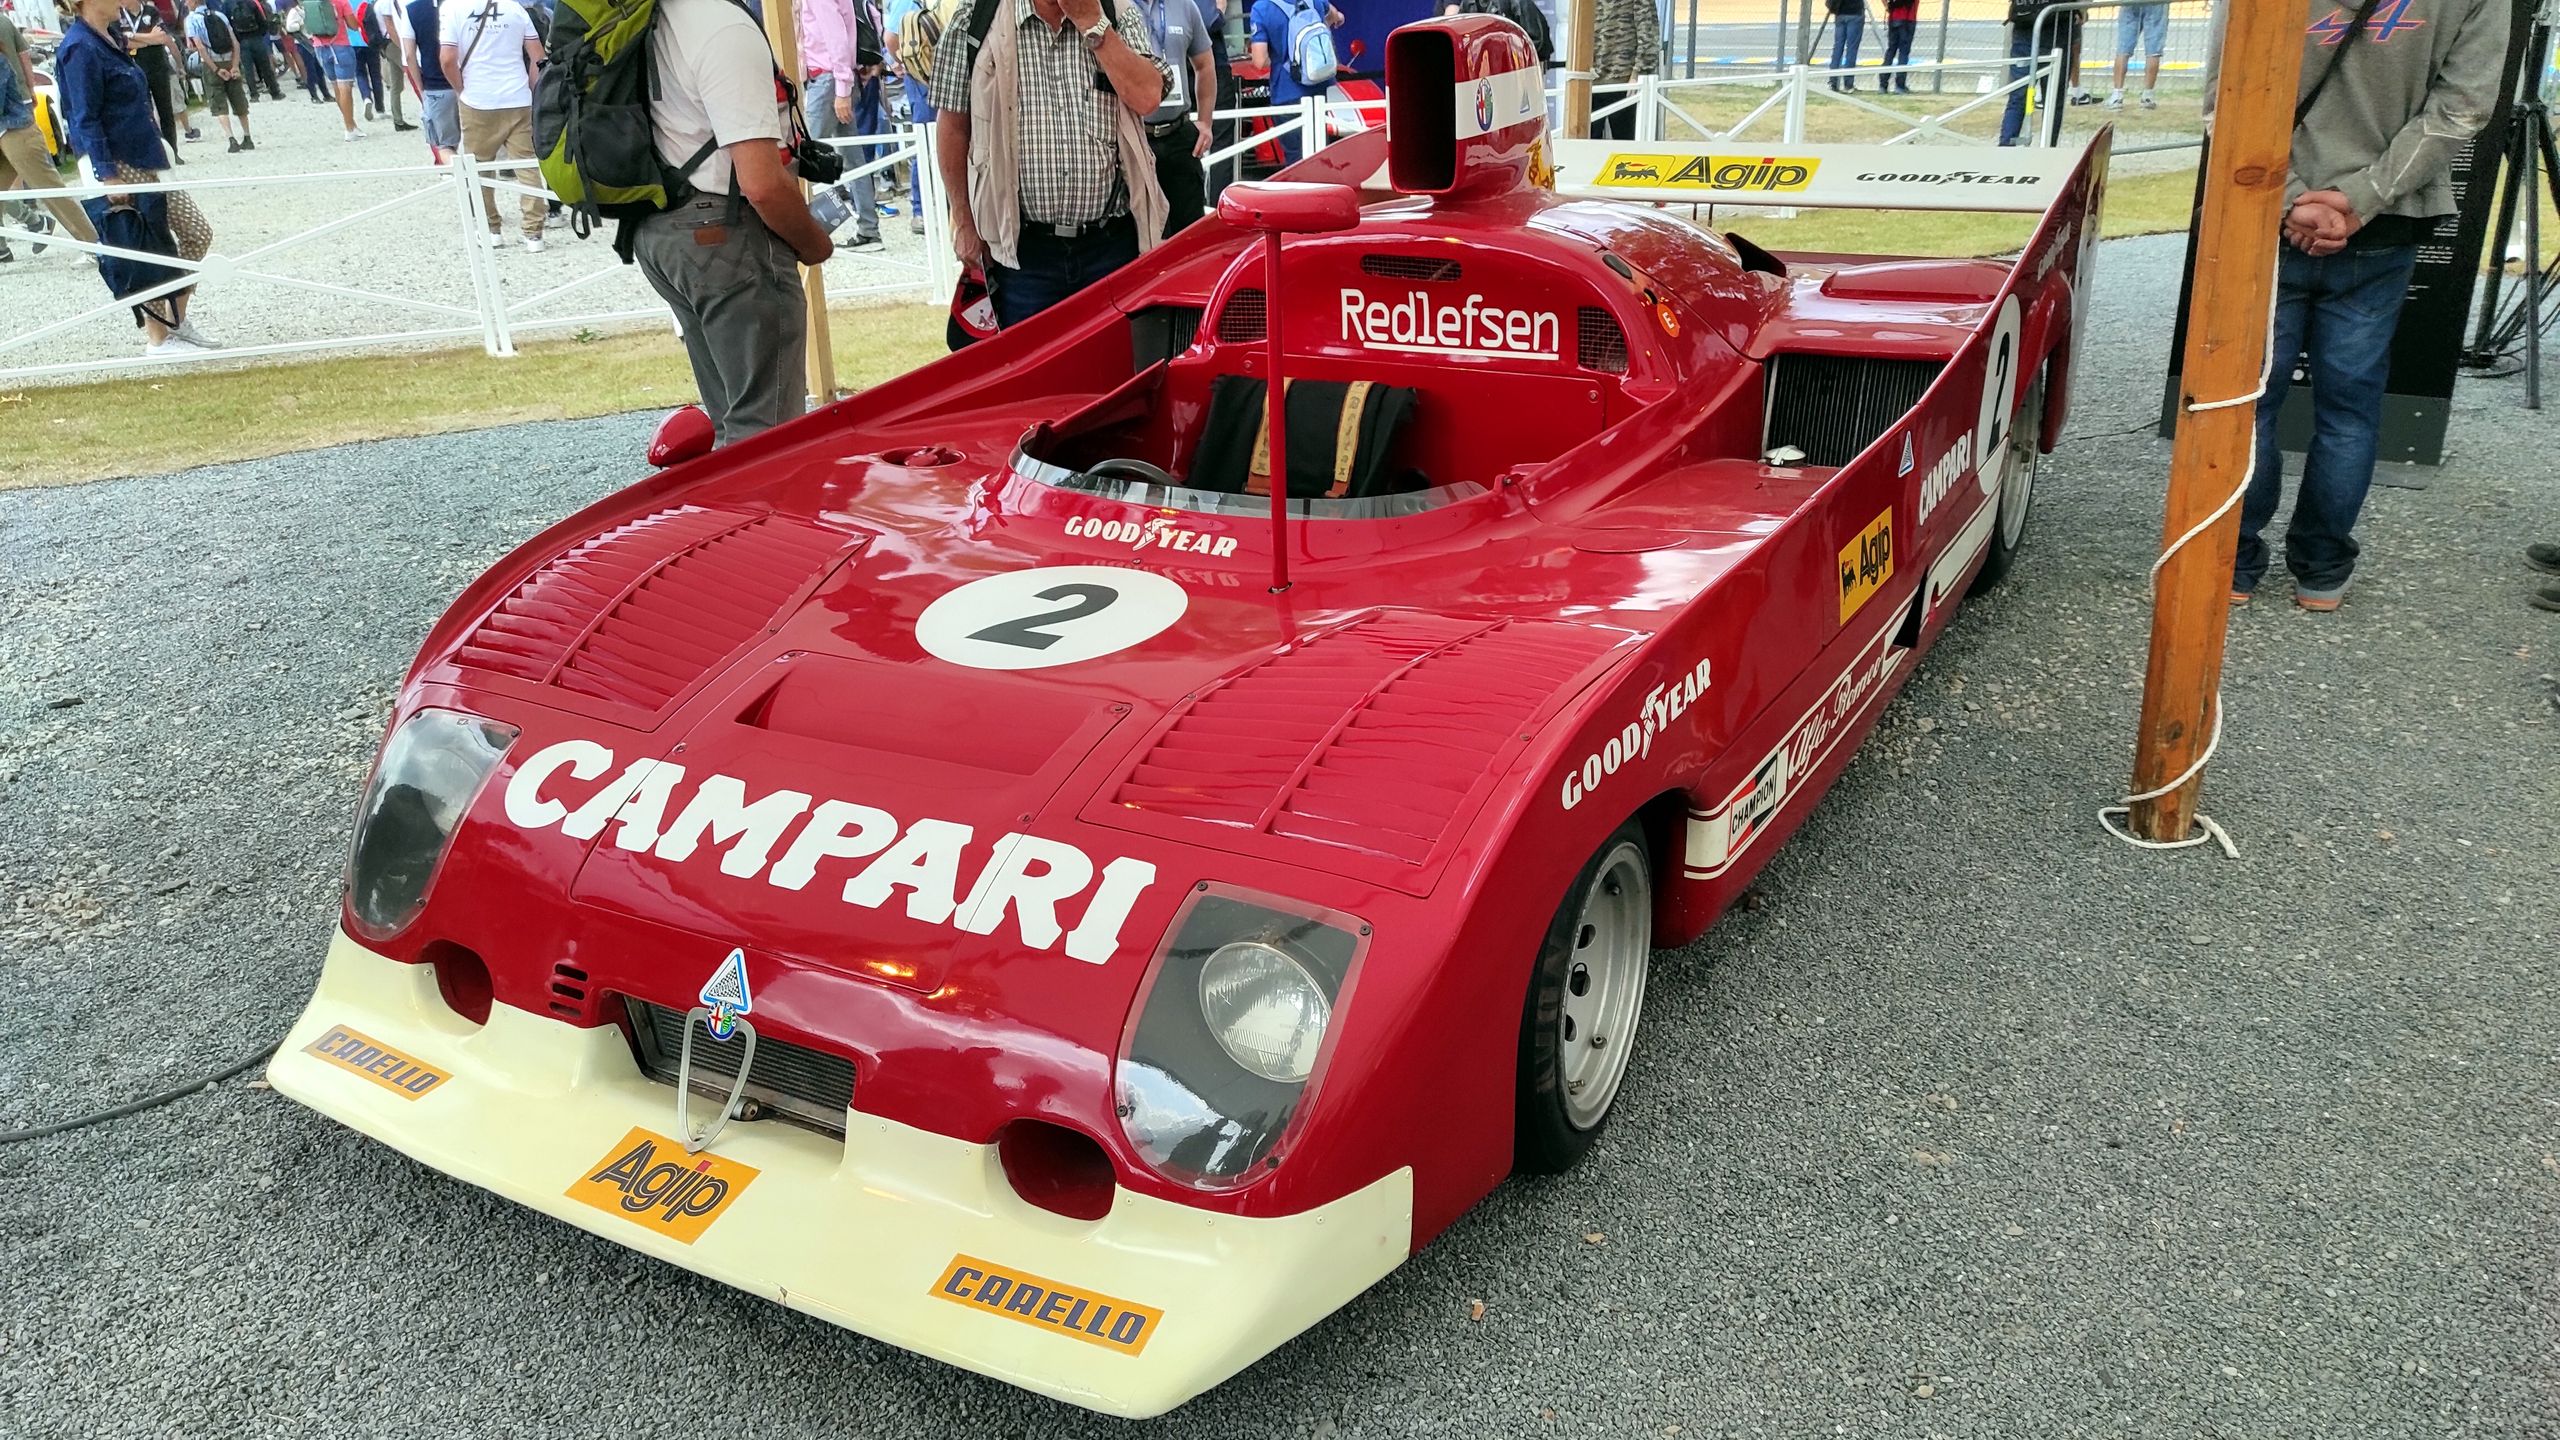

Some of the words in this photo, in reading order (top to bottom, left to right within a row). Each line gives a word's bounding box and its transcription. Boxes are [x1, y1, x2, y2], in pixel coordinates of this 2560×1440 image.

[1665, 156, 1808, 191] Agip
[1340, 288, 1559, 353] Redlefsen
[1662, 312, 1675, 329] E
[1986, 331, 2011, 458] 2
[1918, 428, 1972, 526] CAMPARI
[1859, 520, 1891, 586] Agip
[963, 583, 1120, 651] 2
[1788, 706, 1831, 780] Alfa
[1731, 774, 1775, 835] CHAMPION
[504, 739, 1157, 965] CAMPARI
[316, 1031, 441, 1093] CARELLO
[588, 1139, 730, 1224] Agip
[943, 1266, 1148, 1345] CARELLO
